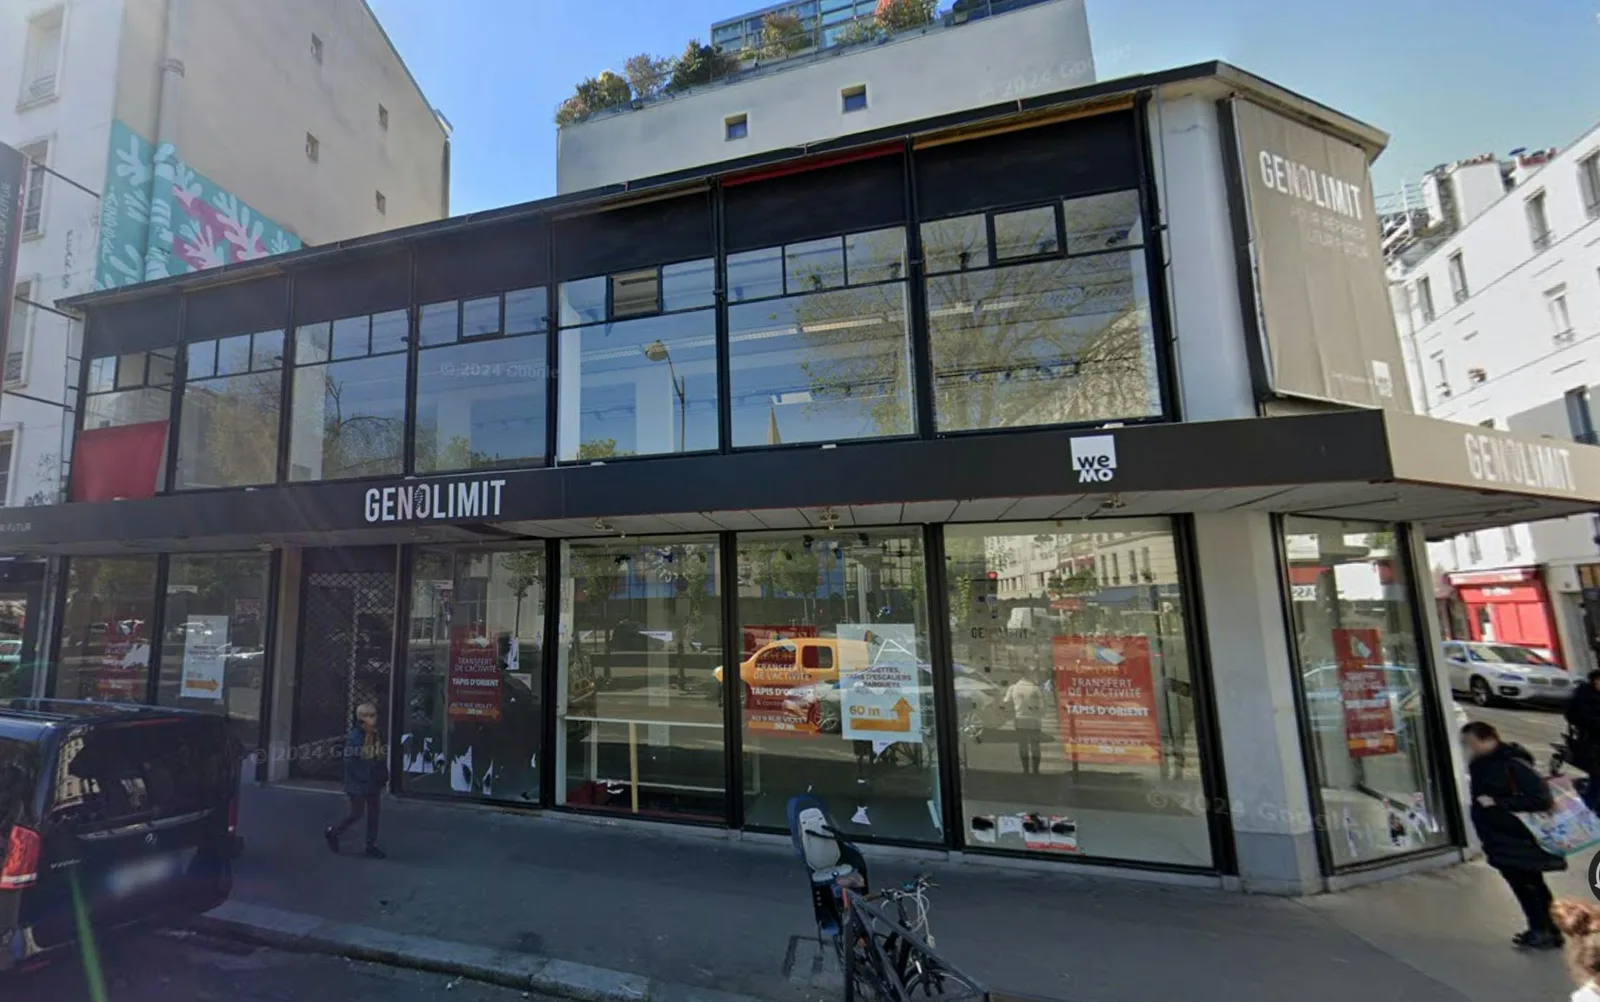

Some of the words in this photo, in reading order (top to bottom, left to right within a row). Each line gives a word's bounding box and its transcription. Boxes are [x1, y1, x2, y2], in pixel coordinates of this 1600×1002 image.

[1259, 150, 1363, 221] GENOLIMIT
[1464, 432, 1577, 492] GENOLIMIT
[364, 479, 507, 522] GENOLIMIT
[753, 671, 765, 680] DE
[452, 677, 469, 686] TAPIS
[1071, 677, 1133, 687] TRANSFERT
[751, 687, 774, 696] TAPIS
[1067, 687, 1082, 697] DE
[849, 704, 865, 716] 60
[868, 707, 880, 717] m
[1065, 704, 1096, 715] TAPIS
[1097, 705, 1149, 717] D'ORIENT
